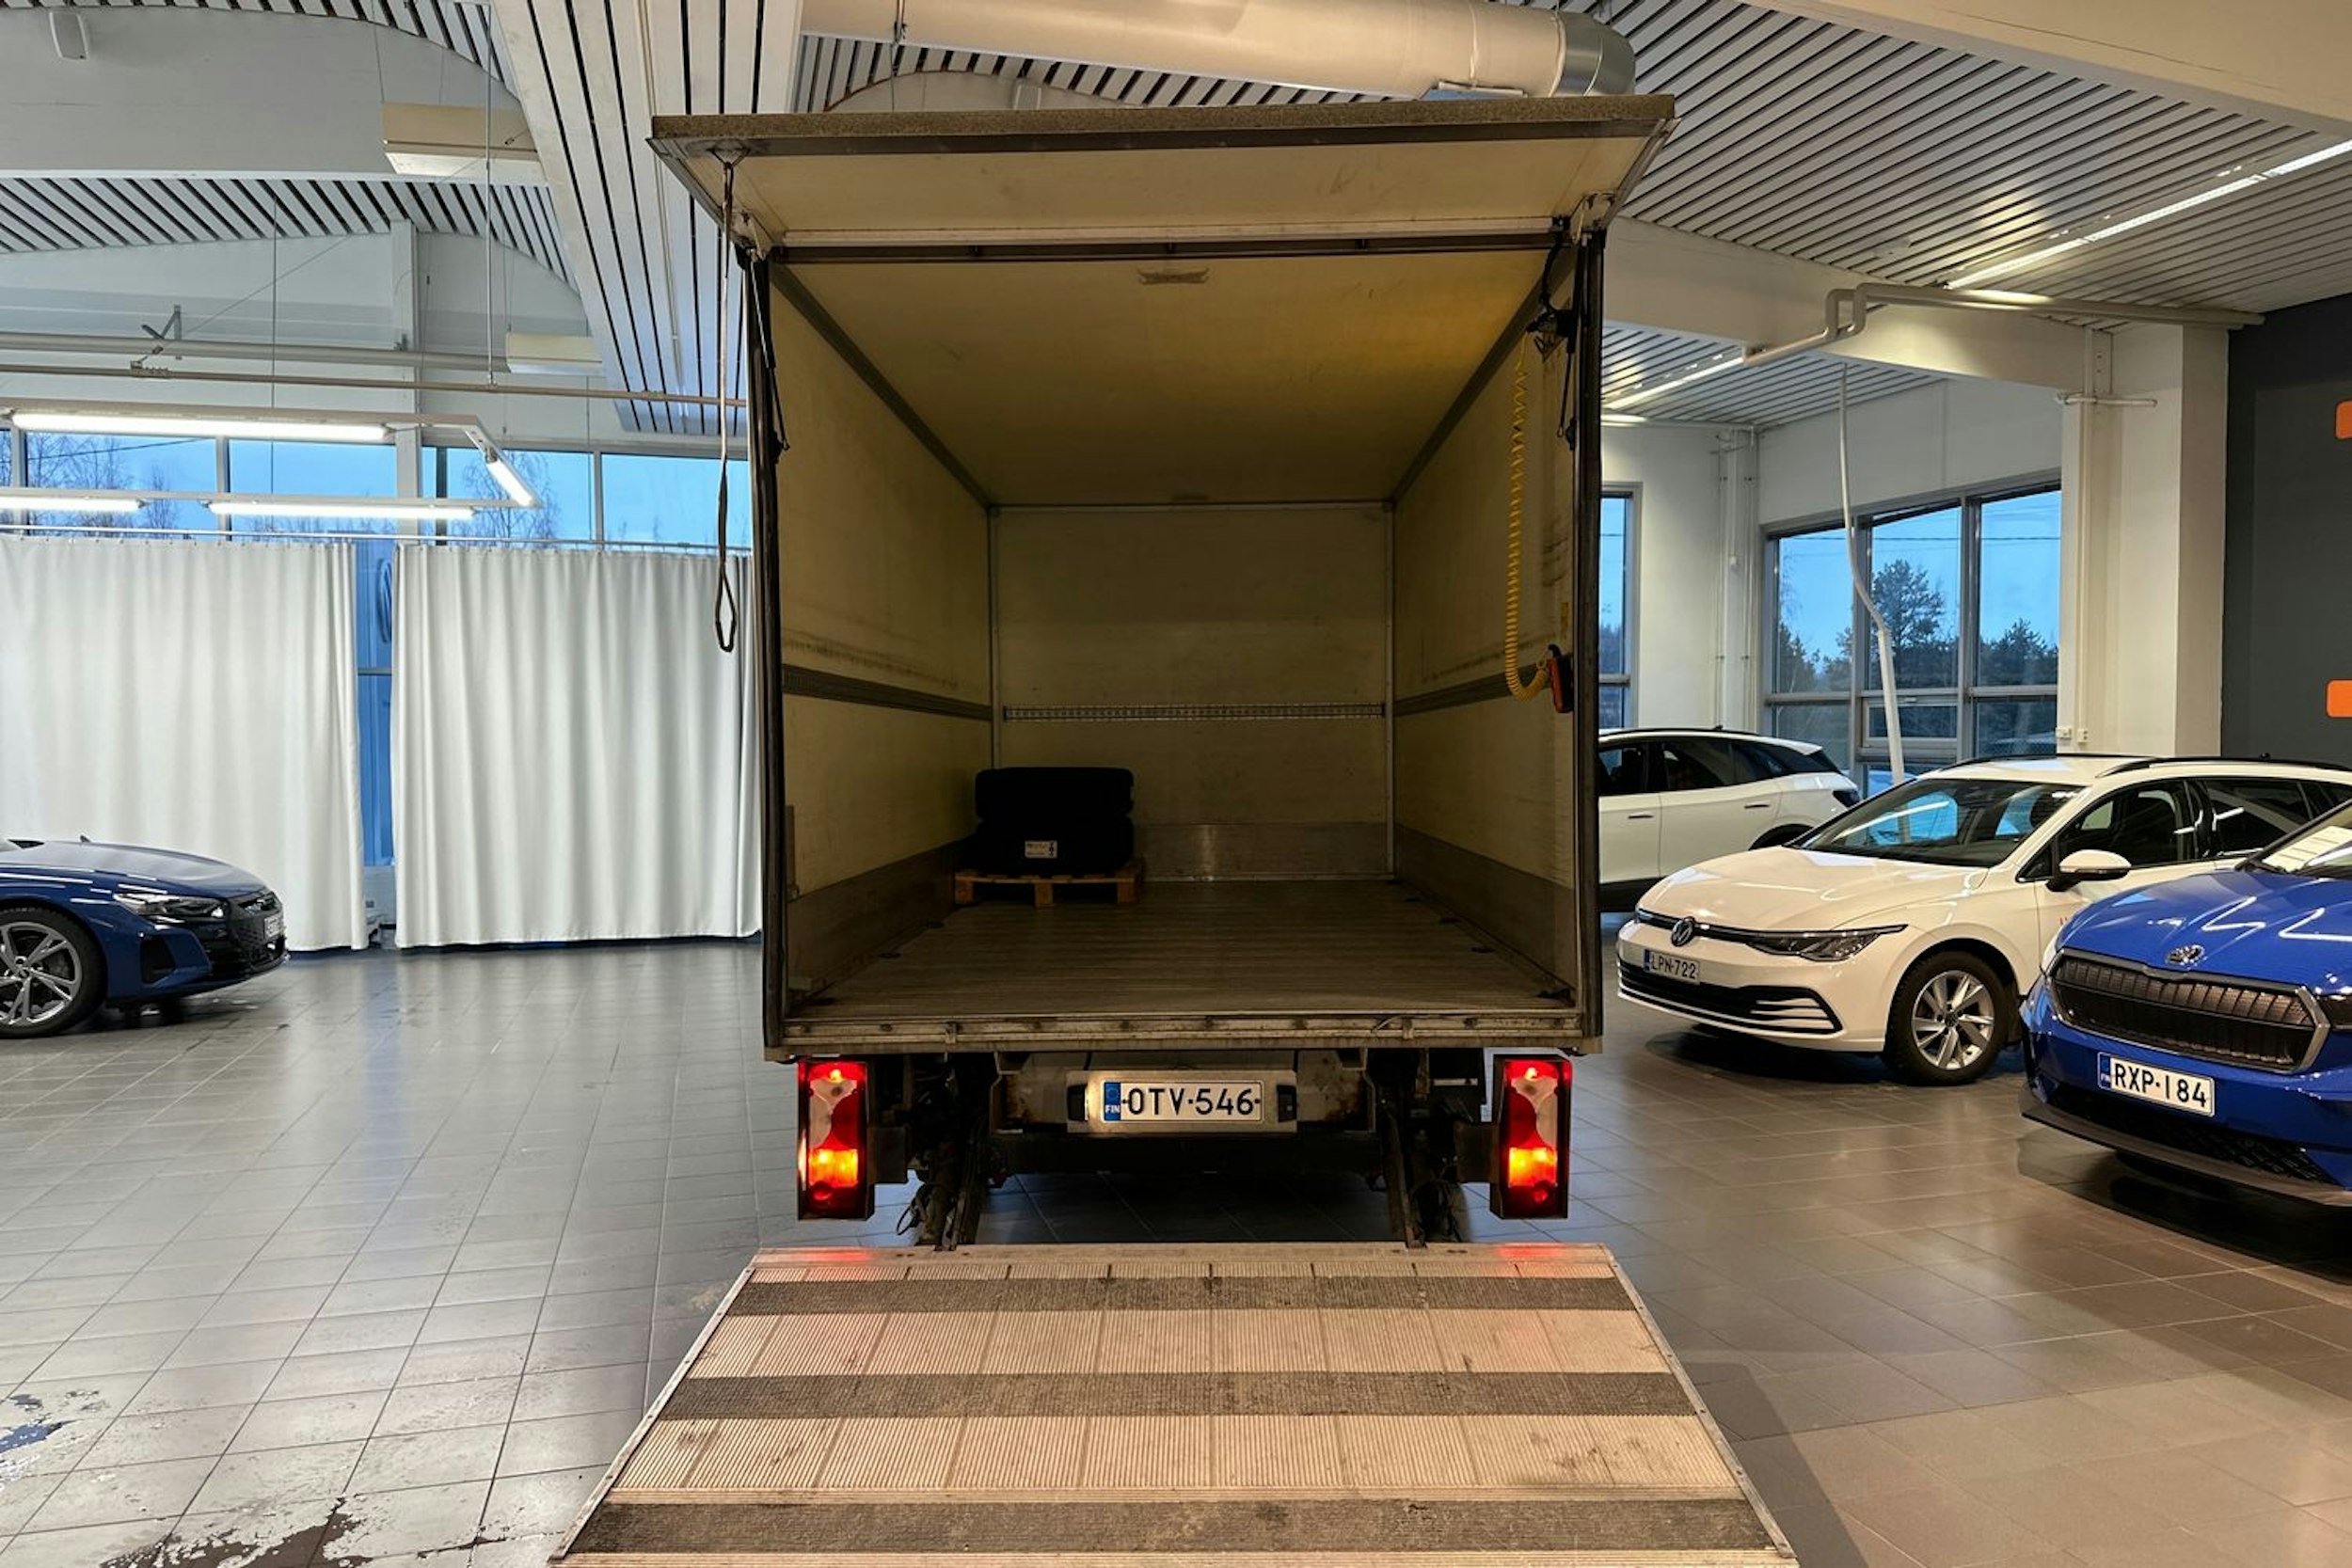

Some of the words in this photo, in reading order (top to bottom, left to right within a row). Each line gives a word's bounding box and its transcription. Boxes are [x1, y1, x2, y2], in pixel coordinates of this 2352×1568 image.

[1651, 954, 1696, 979] LPN-722
[2114, 1063, 2207, 1107] RXP-184
[1104, 1104, 1120, 1114] FIN
[1128, 1088, 1254, 1115] OTV-546
